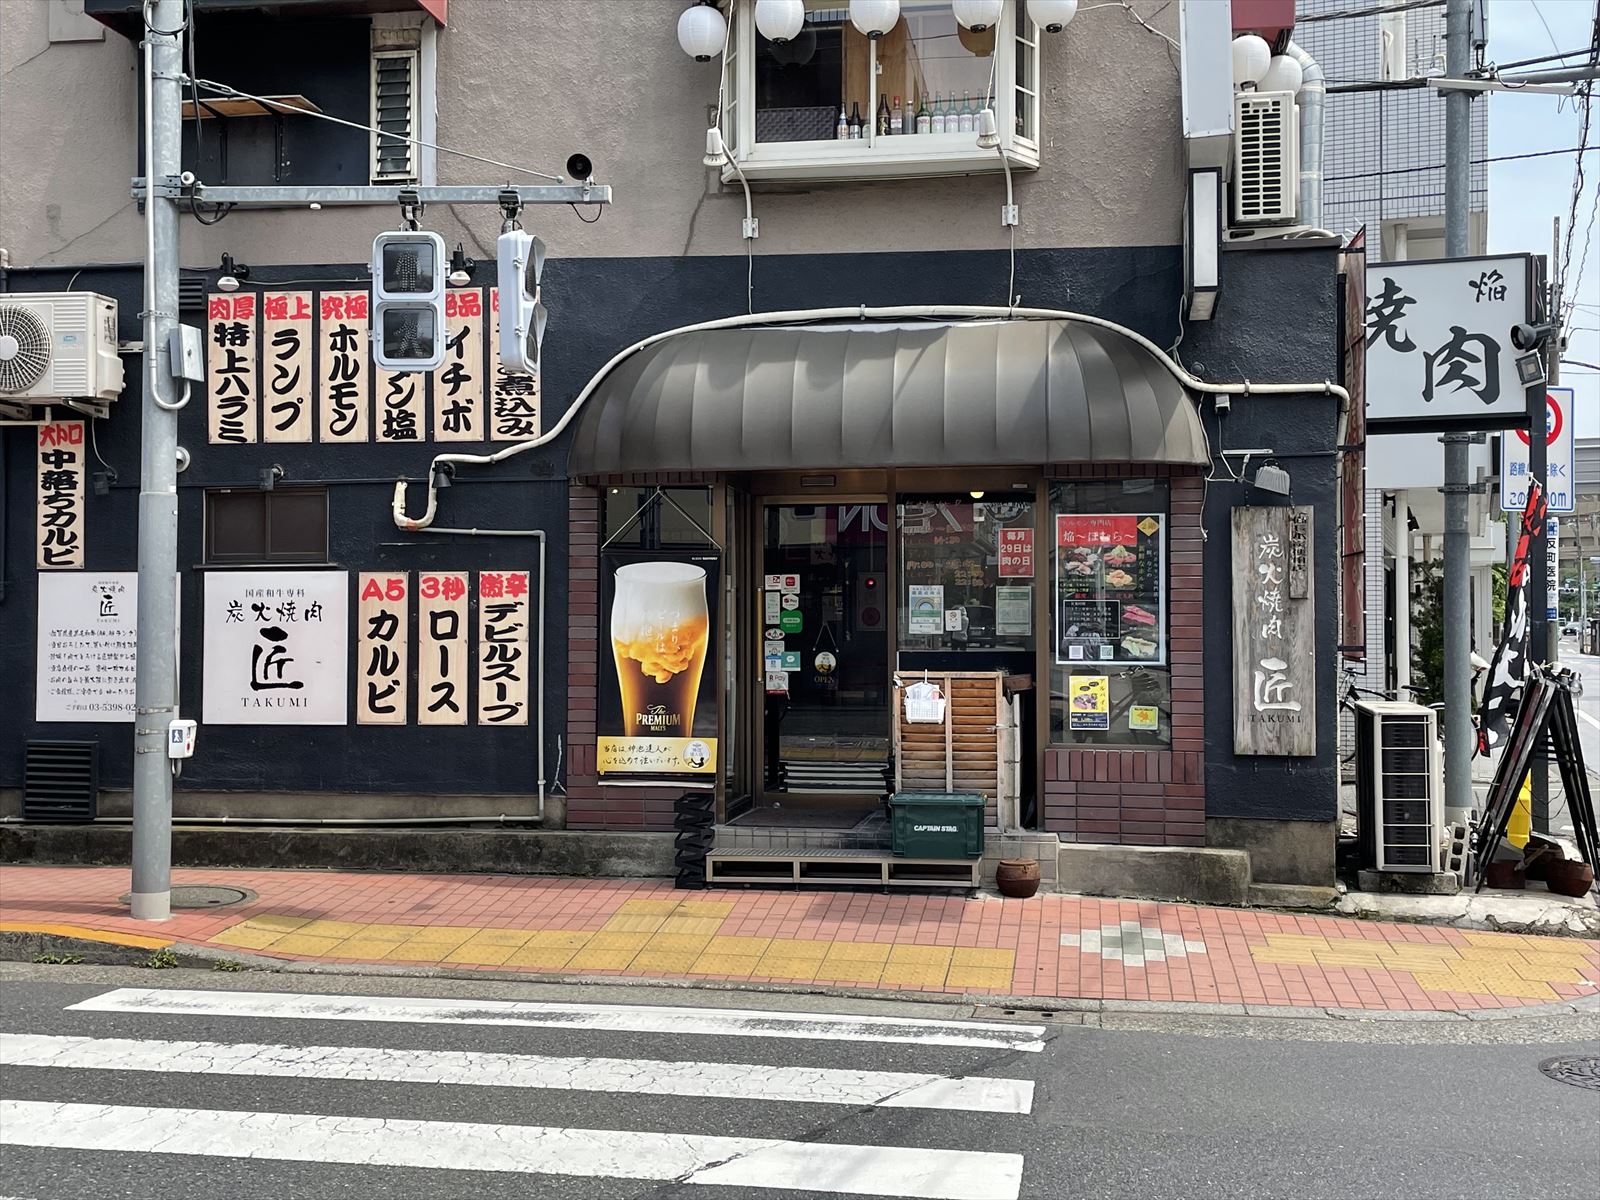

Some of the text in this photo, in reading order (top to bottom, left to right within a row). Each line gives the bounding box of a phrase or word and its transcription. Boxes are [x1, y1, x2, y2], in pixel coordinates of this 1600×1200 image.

[209, 296, 255, 320] 肉厚
[265, 296, 312, 320] 極上
[321, 295, 368, 320] 究極
[213, 321, 251, 443] 特上ハラミ
[271, 328, 304, 431] ランプ
[328, 323, 361, 437] ホルモン
[441, 325, 474, 433] イチボ
[382, 371, 418, 440] ン塩
[40, 448, 80, 566] 中落ちカルビ
[1000, 544, 1032, 553] 29日は
[1006, 531, 1025, 541] 毎月
[1001, 556, 1031, 566] 肉の日
[361, 578, 406, 601] A5
[420, 576, 466, 601] 3秒
[480, 573, 528, 598] 激辛
[1257, 534, 1284, 640] 炭火焼肉
[100, 594, 119, 616] 匠
[225, 600, 323, 623] 炭火焼肉
[250, 625, 304, 691] 匠
[367, 609, 401, 714] カルビ
[427, 609, 460, 713] ロース
[482, 601, 525, 722] デビルスープ
[1253, 657, 1302, 711] 匠
[241, 697, 308, 707] TAKUMI
[635, 712, 681, 726] PREMIUM
[1250, 714, 1301, 723] TAKUMI
